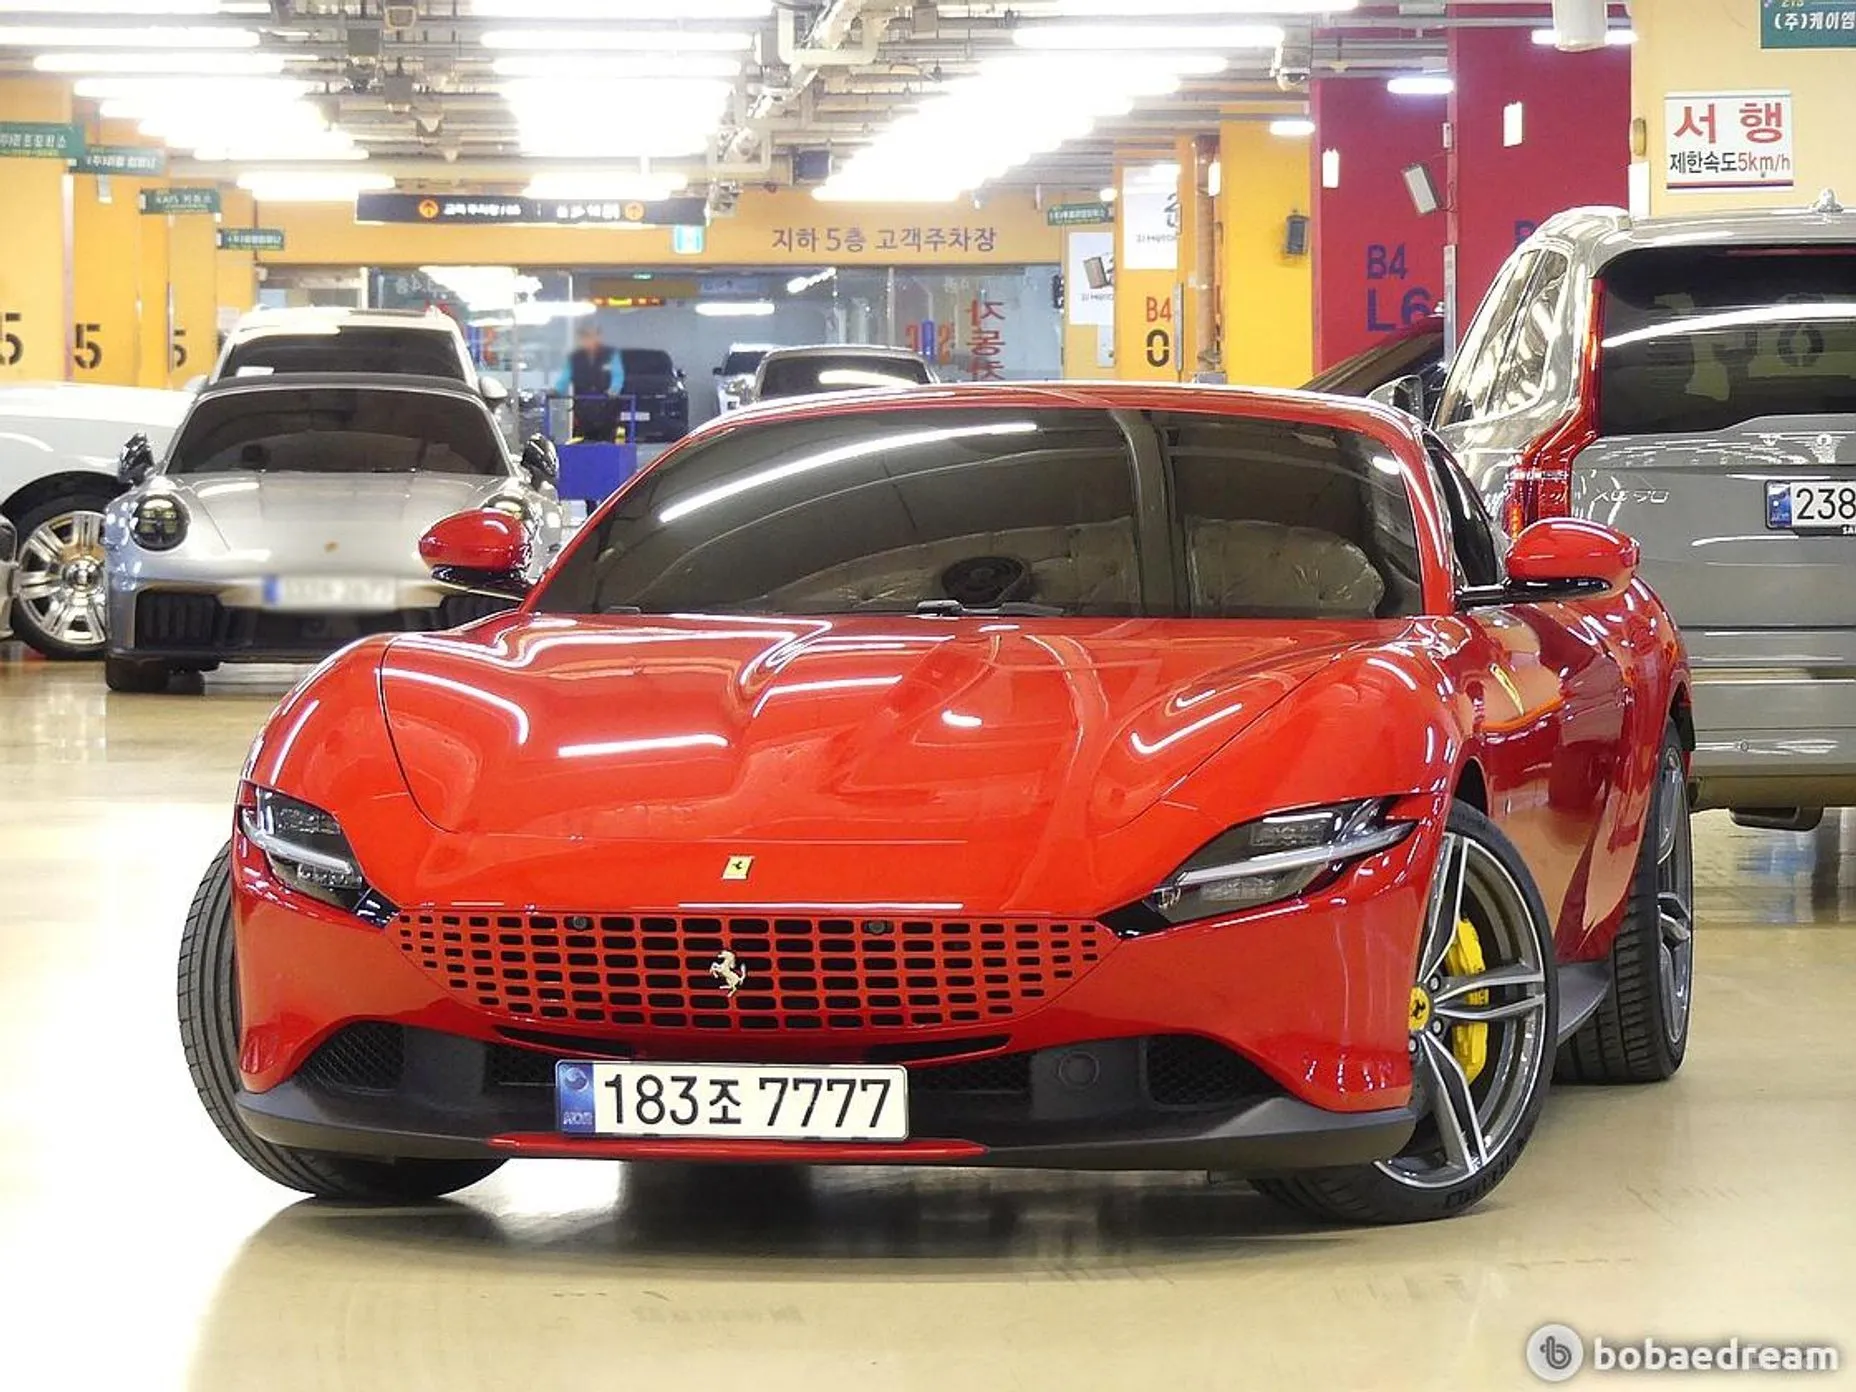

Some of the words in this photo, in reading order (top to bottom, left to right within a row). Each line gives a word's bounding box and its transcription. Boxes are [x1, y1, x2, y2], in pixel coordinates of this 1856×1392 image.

[1673, 103, 1716, 144] 서
[1739, 102, 1783, 143] 행
[772, 227, 820, 252] 지하
[826, 227, 867, 253] 5층
[875, 227, 996, 252] 고객주차장
[1367, 244, 1408, 279] B4
[1146, 297, 1171, 322] B4
[75, 324, 102, 369] 5
[1796, 488, 1856, 519] 238
[605, 1073, 742, 1126] 183조
[759, 1076, 892, 1129] 7777
